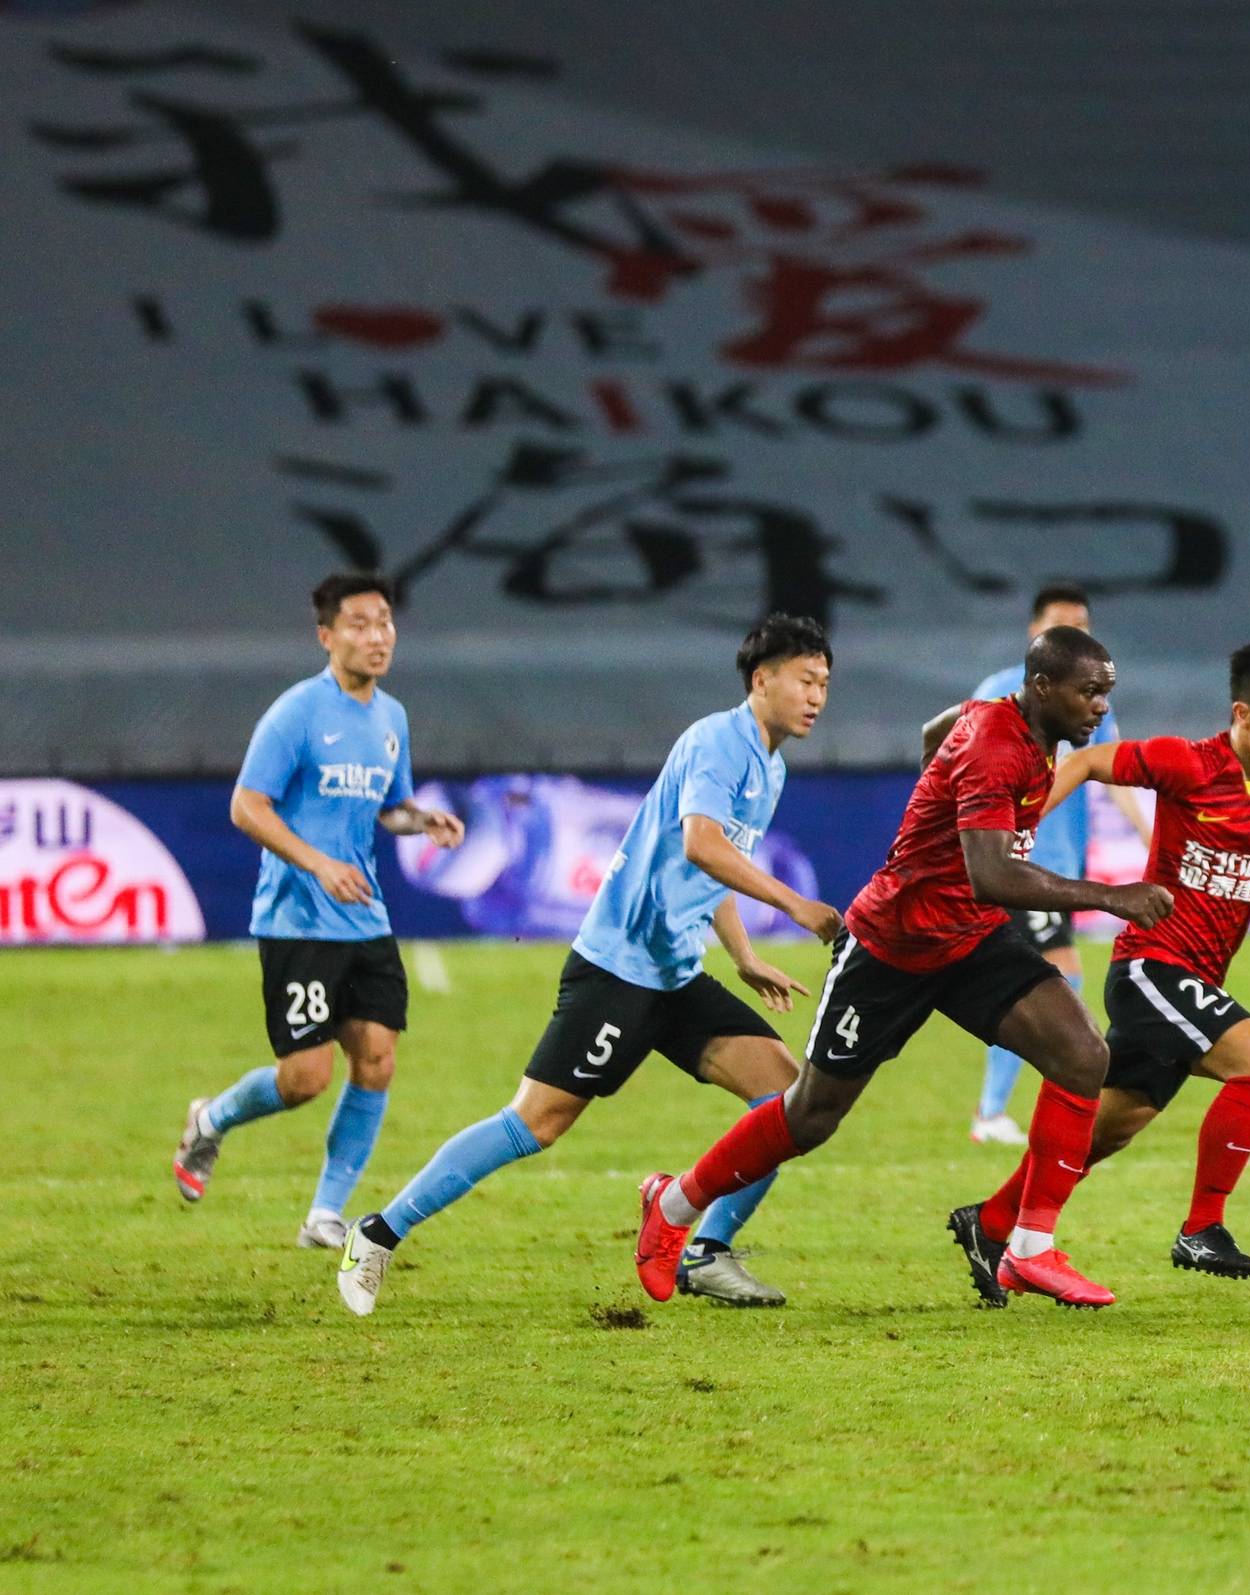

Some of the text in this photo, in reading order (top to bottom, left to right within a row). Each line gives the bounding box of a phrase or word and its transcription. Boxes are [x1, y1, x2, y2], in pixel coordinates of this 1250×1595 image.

[132, 294, 176, 345] I
[296, 370, 1084, 445] HAIKOU
[286, 980, 330, 1025] 28
[586, 1022, 622, 1066] 5
[836, 1004, 861, 1049] 4
